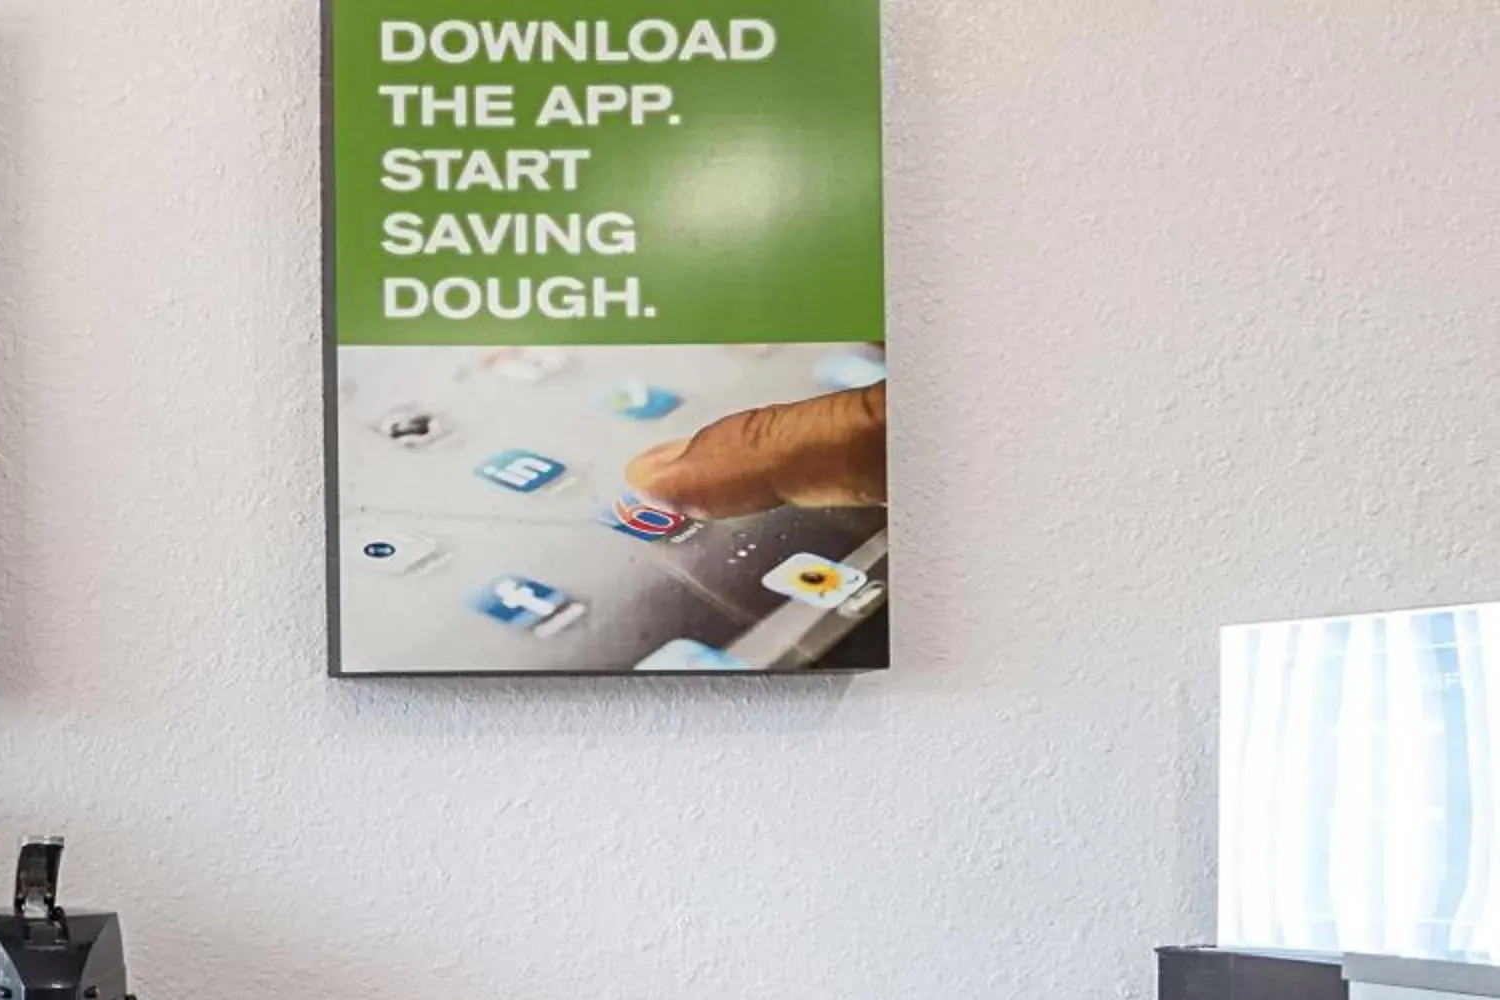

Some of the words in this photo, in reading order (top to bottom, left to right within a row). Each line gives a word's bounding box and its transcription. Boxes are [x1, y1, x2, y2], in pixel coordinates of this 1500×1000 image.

[380, 18, 776, 63] DOWNLOAD
[378, 84, 515, 127] THE
[535, 84, 681, 127] APP.
[380, 147, 591, 192] START
[381, 211, 638, 256] SAVING
[383, 275, 657, 320] DOUGH.
